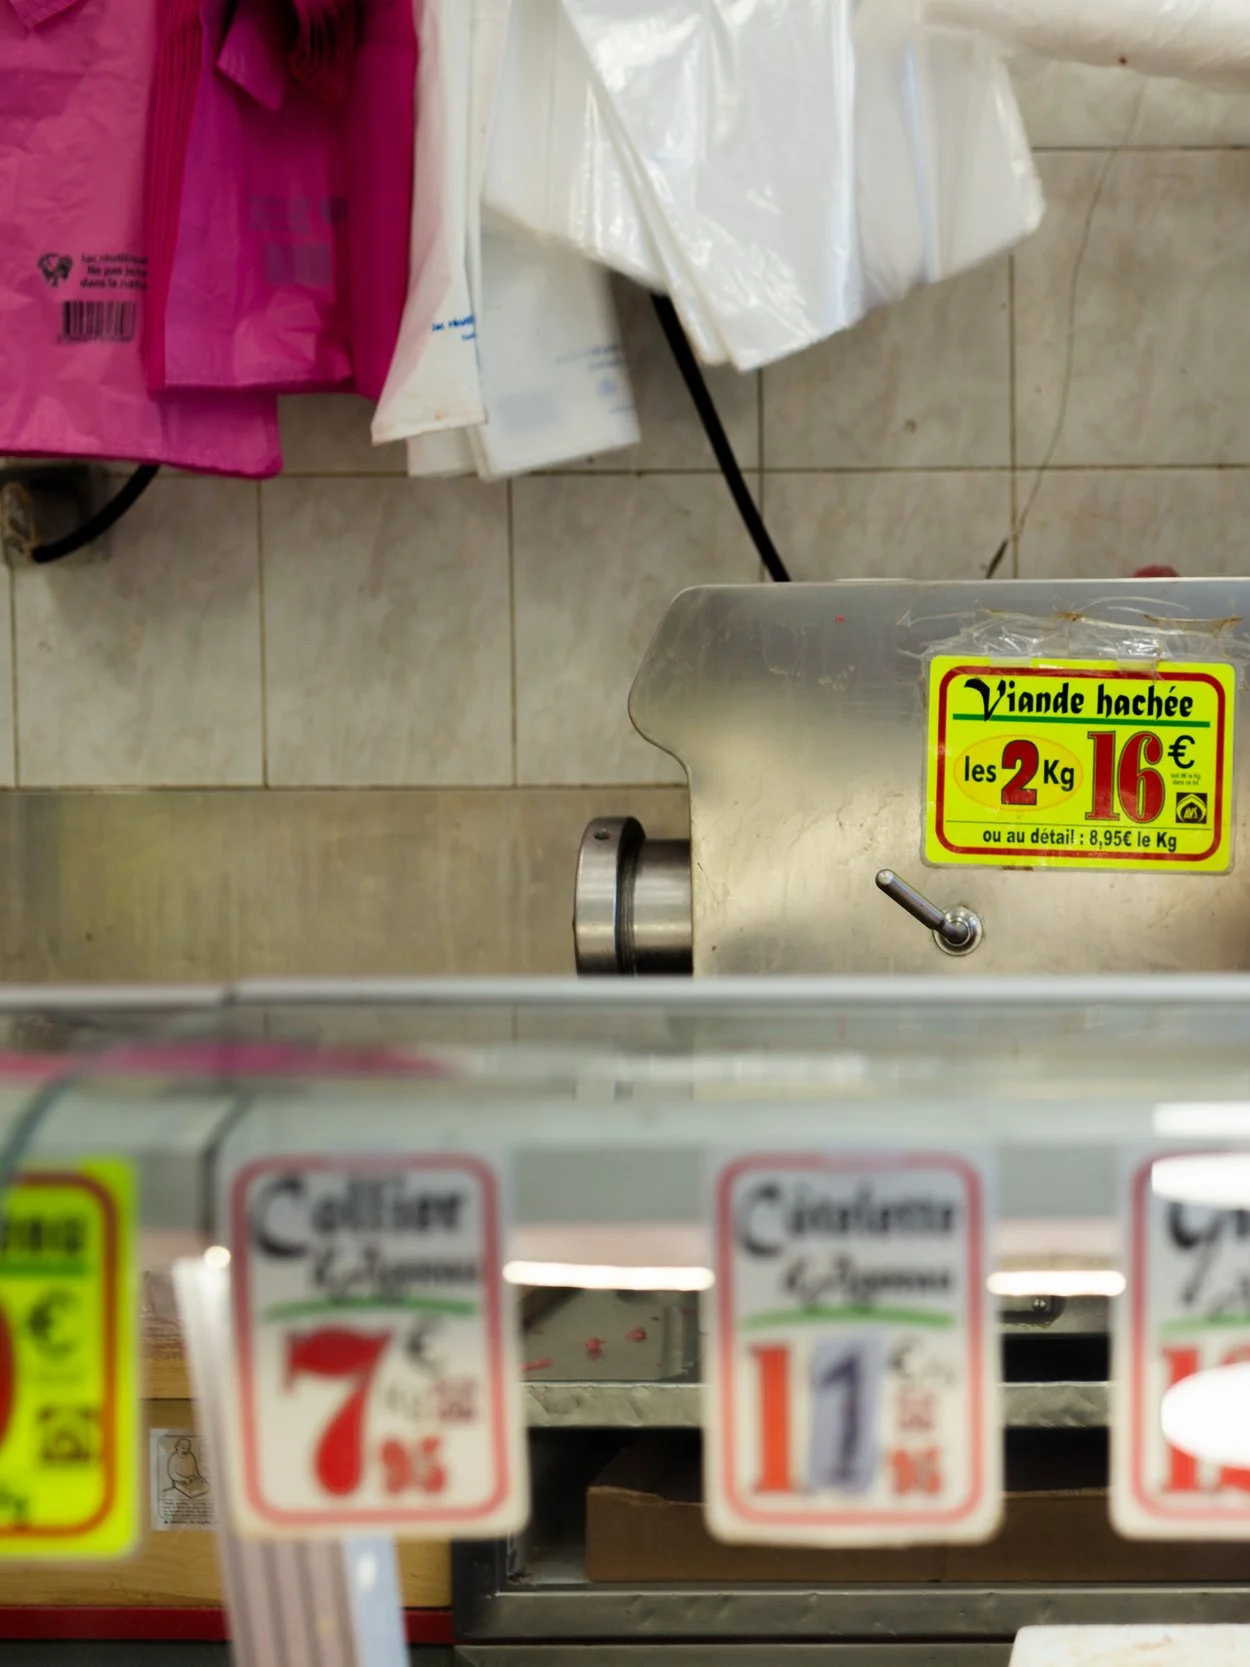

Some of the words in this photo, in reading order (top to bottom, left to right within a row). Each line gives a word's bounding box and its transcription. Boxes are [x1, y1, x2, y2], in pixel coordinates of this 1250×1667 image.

[964, 678, 1085, 722] Viande
[1097, 685, 1194, 720] hachée
[964, 756, 997, 783] les
[1001, 739, 1040, 806] 2
[1043, 760, 1075, 791] Kg
[1085, 730, 1165, 824] 16
[1168, 735, 1195, 769] €
[983, 830, 1000, 843] ou
[1007, 830, 1025, 844] au
[1031, 828, 1074, 846] détail
[1090, 830, 1132, 849] 8,95€
[1137, 832, 1150, 847] le
[1156, 832, 1177, 852] Kg
[250, 1172, 462, 1260] Collier
[284, 1324, 396, 1498] 7
[378, 1436, 448, 1496] 95
